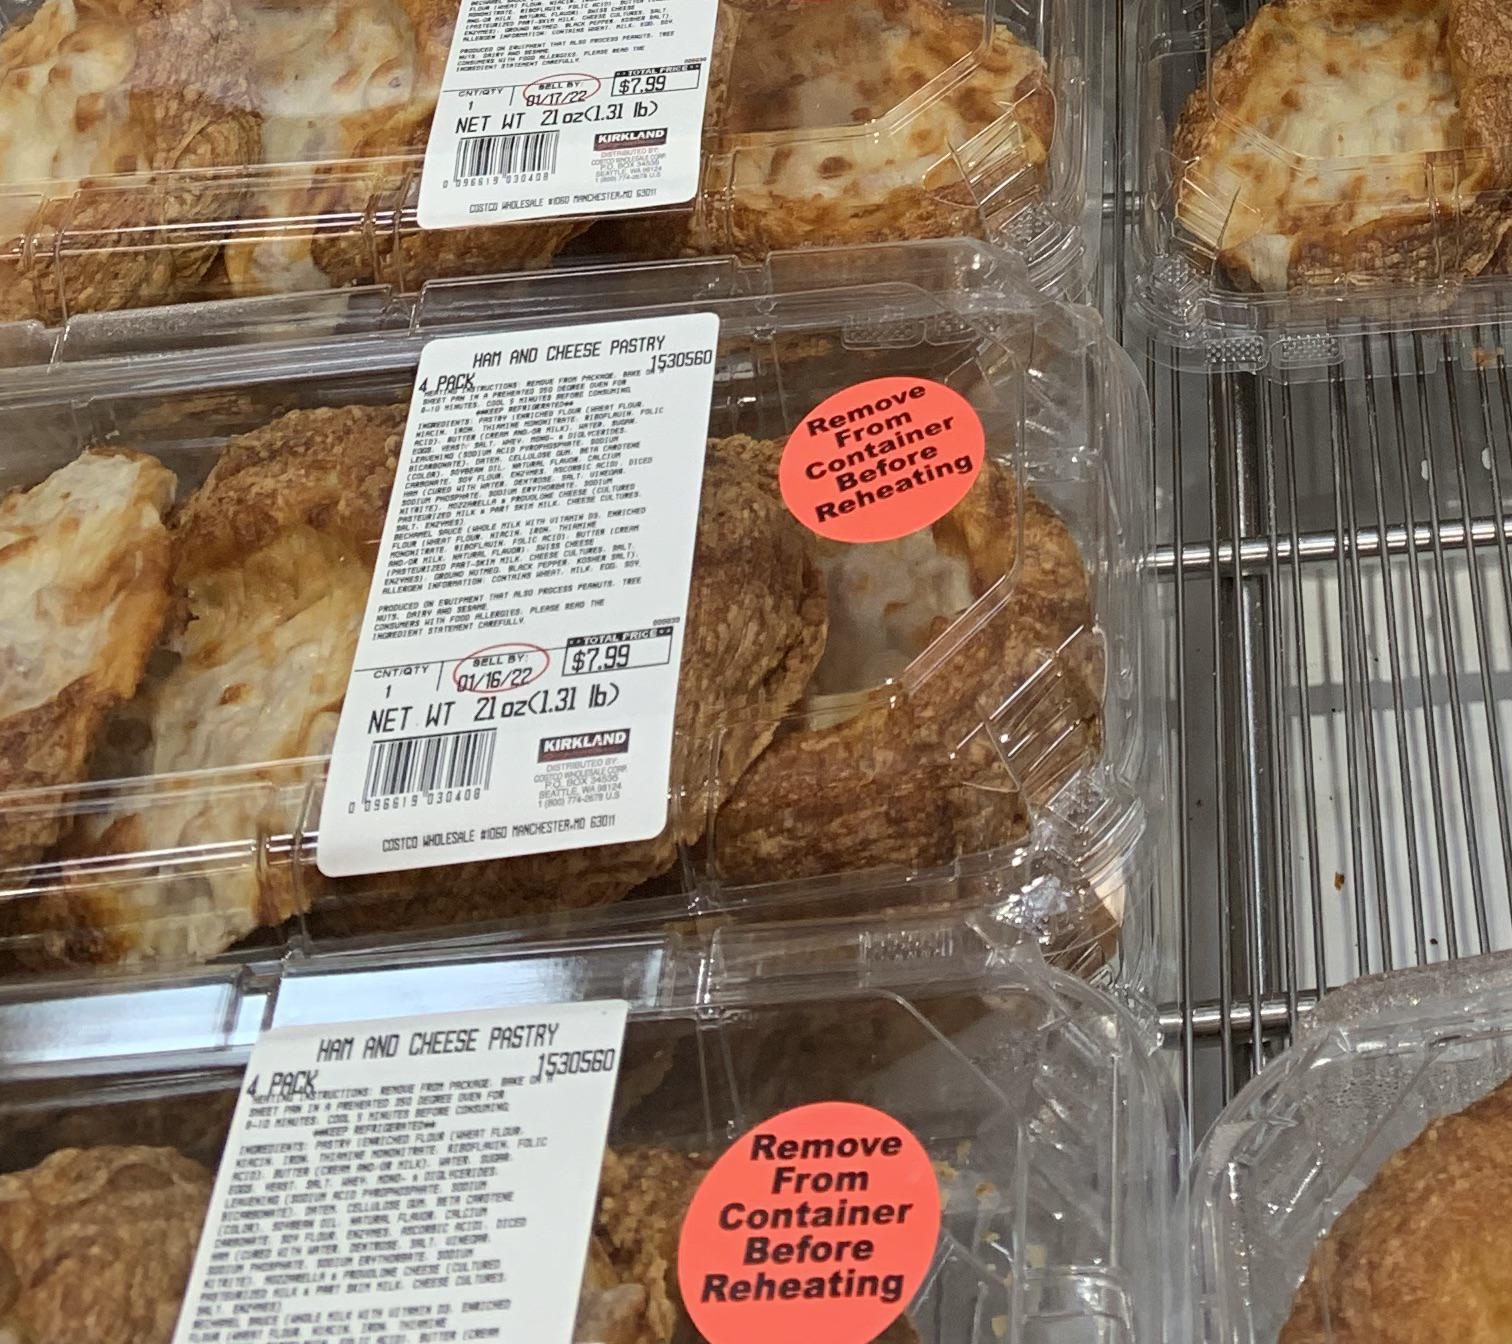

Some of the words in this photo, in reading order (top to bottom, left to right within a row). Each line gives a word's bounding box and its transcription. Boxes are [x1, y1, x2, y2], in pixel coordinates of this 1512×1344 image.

[618, 76, 667, 94] $7.99
[598, 130, 665, 145] KIRKLAND
[473, 351, 501, 368] HAM
[510, 348, 537, 365] AND
[547, 342, 600, 361] CHEESE
[610, 336, 665, 355] PASTRY
[650, 350, 713, 372] 1530560
[418, 378, 429, 393] 4
[437, 373, 476, 389] PACK
[806, 385, 926, 437] Remove
[834, 411, 913, 449] From
[805, 416, 955, 480] Container
[835, 446, 938, 492] Before
[815, 455, 974, 523] Reheating
[572, 644, 629, 673] $7.99
[457, 668, 532, 692] 01/16/22
[368, 707, 413, 734] NET
[426, 701, 455, 726] WT
[474, 697, 494, 721] 21
[589, 683, 619, 708] lb)
[543, 732, 626, 752] KIRKLAND
[383, 836, 417, 852] COSTCO
[423, 830, 474, 848] WHOLESALE
[317, 1038, 354, 1062] HAM
[363, 1034, 398, 1057] AND
[409, 1029, 479, 1055] CHEESE
[488, 1023, 559, 1050] PASTRY
[536, 1048, 615, 1078] 1530560
[248, 1074, 259, 1096] 4
[272, 1070, 318, 1094] PACK
[751, 1134, 903, 1161] Remove
[771, 1166, 869, 1194] From
[718, 1199, 914, 1231] Container
[743, 1235, 874, 1266] Before
[701, 1269, 905, 1304] Reheating
